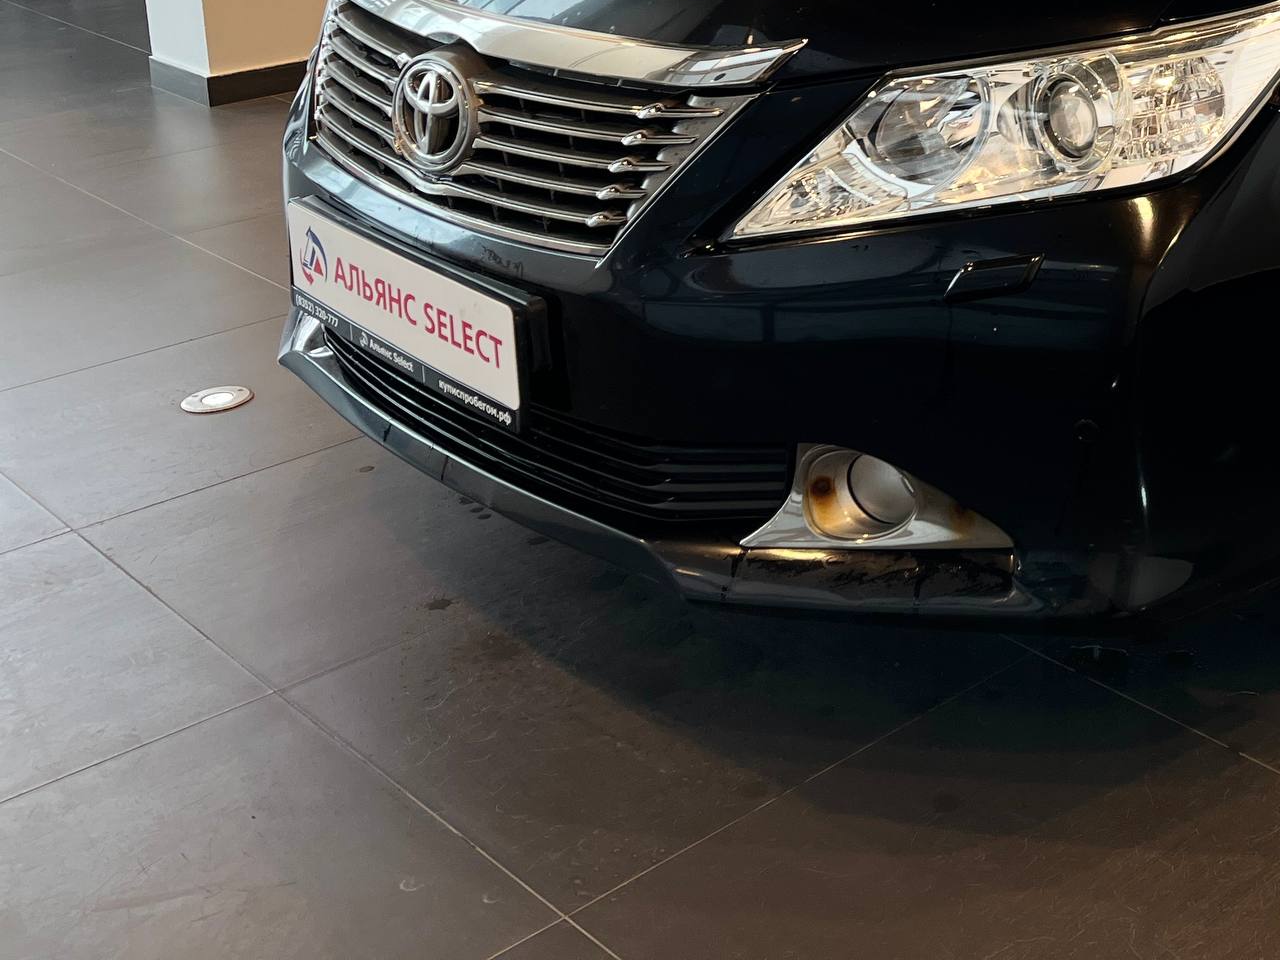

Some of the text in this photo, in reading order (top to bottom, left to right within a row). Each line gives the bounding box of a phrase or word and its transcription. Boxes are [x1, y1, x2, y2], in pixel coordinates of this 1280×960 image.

[334, 256, 503, 369] АЛЬЯНС SELECT
[438, 379, 513, 426] куписпробегом.рф
